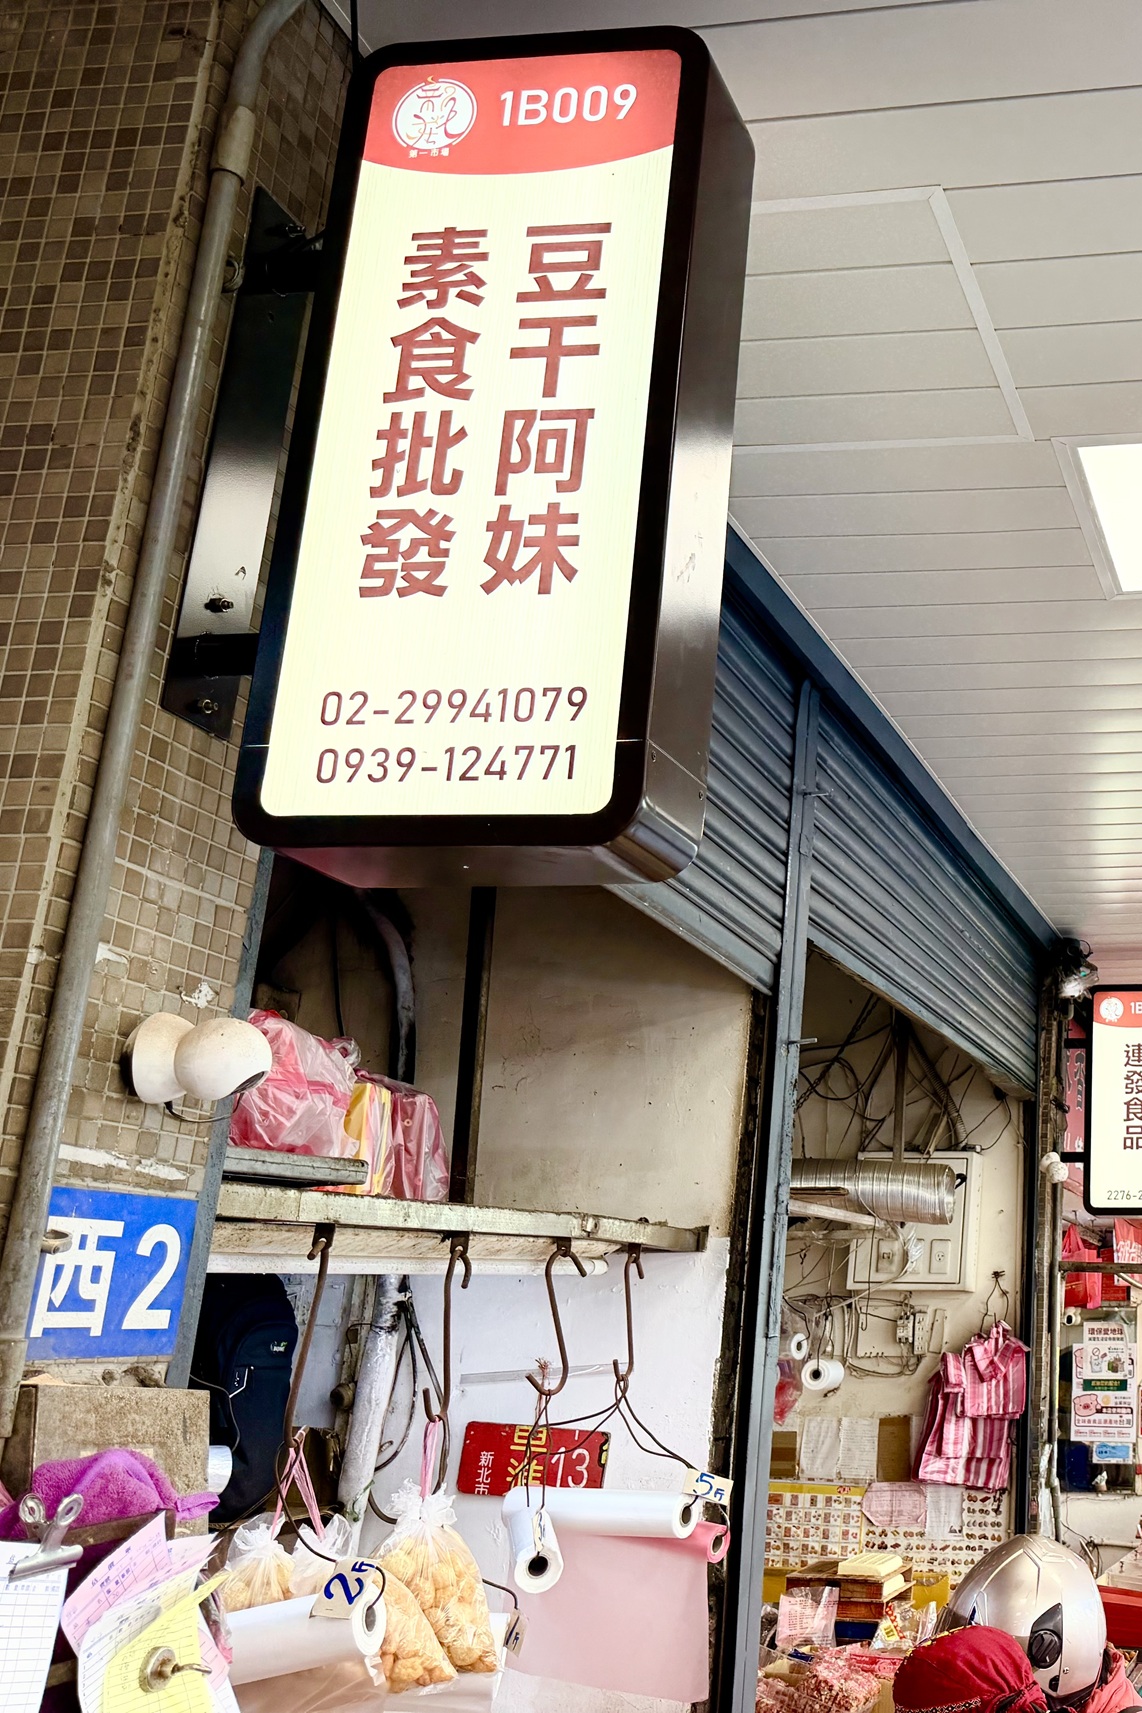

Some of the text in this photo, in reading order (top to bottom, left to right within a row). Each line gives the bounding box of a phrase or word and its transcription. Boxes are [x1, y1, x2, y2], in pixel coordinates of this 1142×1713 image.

[499, 83, 638, 127] 1B009
[358, 226, 490, 599] 素食批發
[479, 222, 613, 596] 豆干阿妹
[319, 686, 589, 726] 02-29941079
[316, 744, 577, 784] 0939-124771
[30, 1216, 182, 1338] 西2
[474, 1450, 495, 1496] 新北市
[551, 1446, 590, 1488] 13
[693, 1472, 726, 1502] 5斤
[323, 1560, 378, 1606] 2斤
